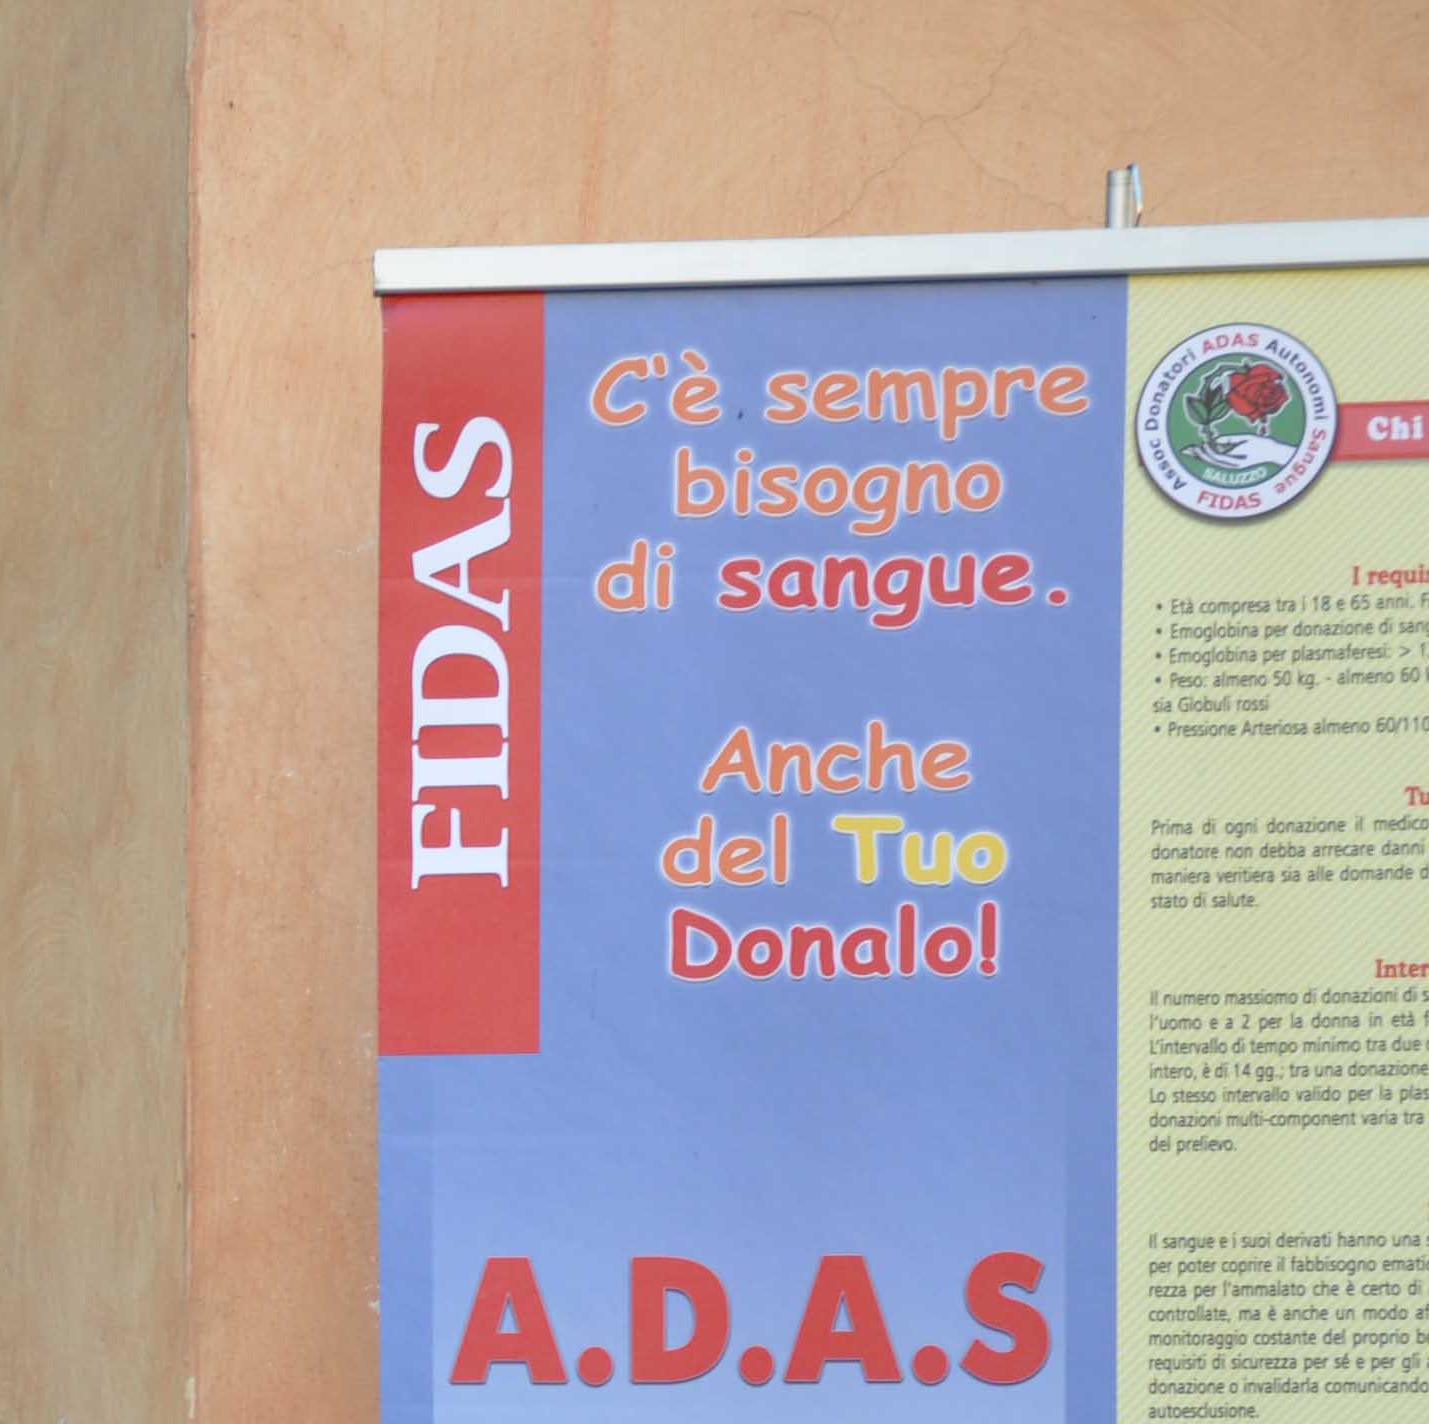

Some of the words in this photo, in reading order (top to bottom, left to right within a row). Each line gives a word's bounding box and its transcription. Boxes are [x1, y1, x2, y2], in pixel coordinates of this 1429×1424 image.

[1202, 333, 1260, 354] ADAS
[1145, 349, 1196, 431] Donatori
[1265, 340, 1330, 421] Autonomi
[590, 350, 723, 427] C'è
[764, 364, 1090, 441] sempre
[1367, 415, 1424, 441] Chi
[1149, 439, 1187, 490] Assoc
[1275, 428, 1326, 494] Sangue
[1202, 467, 1267, 485] SALUZZO
[674, 448, 1003, 536] bisogno
[1197, 490, 1262, 510] FIDAS
[595, 540, 676, 613] di
[718, 552, 1069, 630] sangue.
[1171, 598, 1194, 614] Età
[1200, 600, 1270, 616] compresa
[1277, 598, 1296, 612] tra
[1302, 596, 1306, 611] i
[1313, 596, 1330, 611] 18
[1336, 598, 1345, 611] e
[1350, 595, 1371, 610] 65
[1375, 593, 1413, 610] anni.
[1171, 622, 1259, 642] Emoglobina
[1265, 625, 1288, 643] per
[1293, 621, 1373, 637] donazione
[1379, 618, 1392, 634] di
[411, 415, 514, 889] FIDAS
[1153, 699, 1172, 713] sia
[1178, 696, 1231, 712] Globuli
[1237, 695, 1269, 711] rossi
[1168, 721, 1237, 737] Pressione
[1241, 721, 1307, 736] Arteriosa
[1314, 718, 1370, 735] almeno
[700, 719, 972, 795] Anche
[660, 814, 790, 888] del
[831, 813, 1008, 886] Tuo
[1152, 844, 1219, 860] donatore
[1225, 846, 1253, 859] non
[1260, 842, 1306, 858] debba
[1312, 844, 1374, 857] arrecare
[1381, 840, 1425, 856] danni
[1151, 894, 1188, 909] stato
[1193, 893, 1206, 908] di
[1212, 893, 1258, 908] salute.
[670, 901, 999, 982] Donalo!
[1150, 1136, 1171, 1152] del
[1177, 1136, 1237, 1155] prelievo.
[450, 1251, 1053, 1387] A.D.A.S
[1149, 1330, 1247, 1349] monitoraggio
[1149, 1403, 1258, 1419] autoesclusione.
